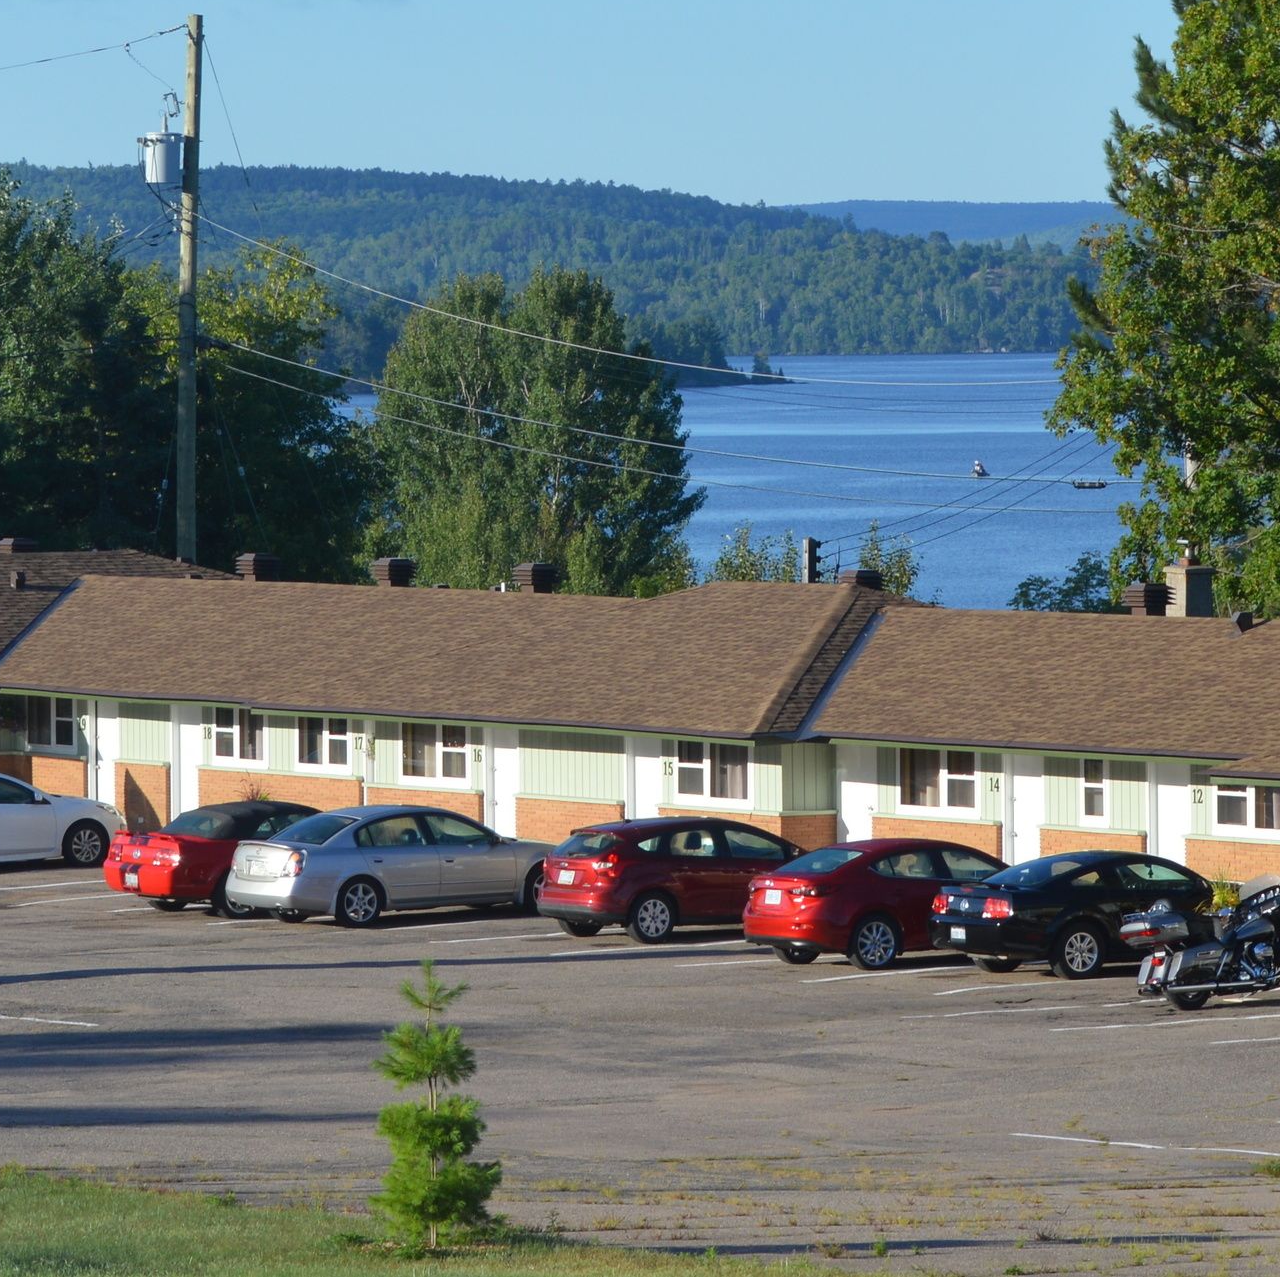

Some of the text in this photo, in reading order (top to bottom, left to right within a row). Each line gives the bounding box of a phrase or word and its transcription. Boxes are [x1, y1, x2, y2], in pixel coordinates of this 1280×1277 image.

[203, 726, 213, 740] 18
[354, 736, 363, 750] 17
[473, 748, 482, 763] 16
[663, 761, 674, 776] 15
[989, 777, 1000, 793] 14
[1192, 788, 1204, 804] 12
